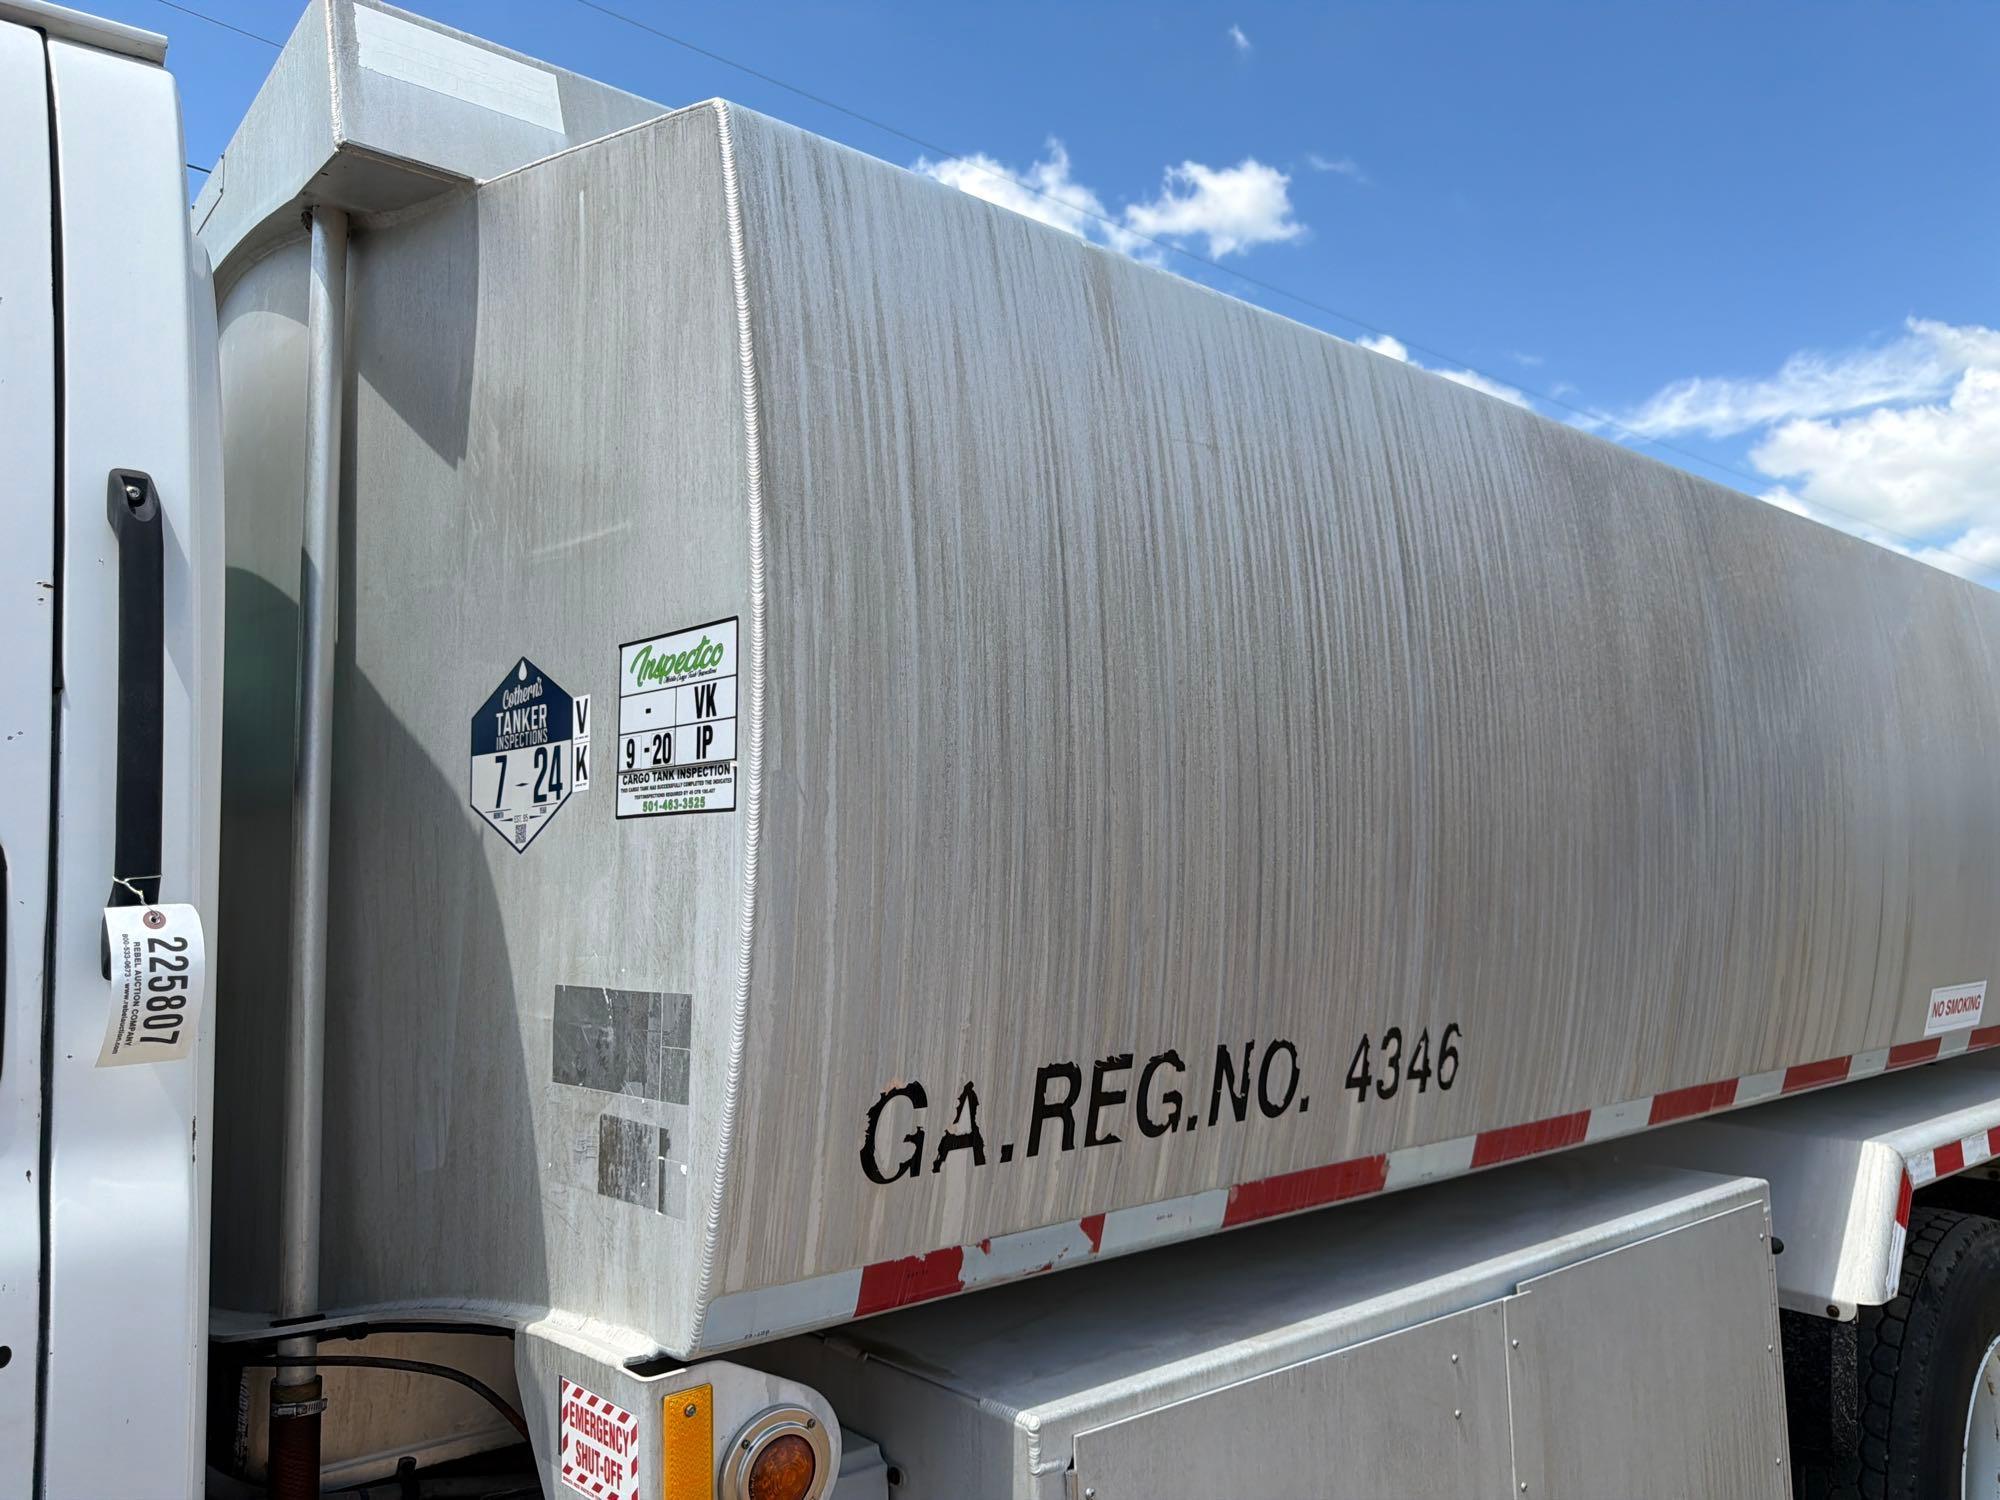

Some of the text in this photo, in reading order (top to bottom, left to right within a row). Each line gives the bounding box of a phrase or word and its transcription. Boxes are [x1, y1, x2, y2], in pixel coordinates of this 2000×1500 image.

[630, 635, 724, 687] Inspectco
[502, 676, 543, 710] Cothern's
[694, 683, 718, 719] VK
[496, 704, 548, 737] TANKER
[576, 698, 588, 734] V
[496, 727, 548, 751] INSPECTIONS
[626, 738, 636, 769] 9
[696, 724, 713, 760] IP
[576, 745, 588, 782] K
[622, 762, 731, 786] CARGO TANK INSPECTION
[124, 941, 142, 1047] REBEL AUCTION COMPANY
[140, 936, 189, 1045] 225807
[1932, 994, 1982, 1018] NO SMOKING
[111, 982, 131, 1055] www.rebelauction.com
[1345, 1022, 1463, 1103] 4346
[570, 1400, 630, 1458] EMERGENCY
[575, 1439, 623, 1491] SHUT-OFF
